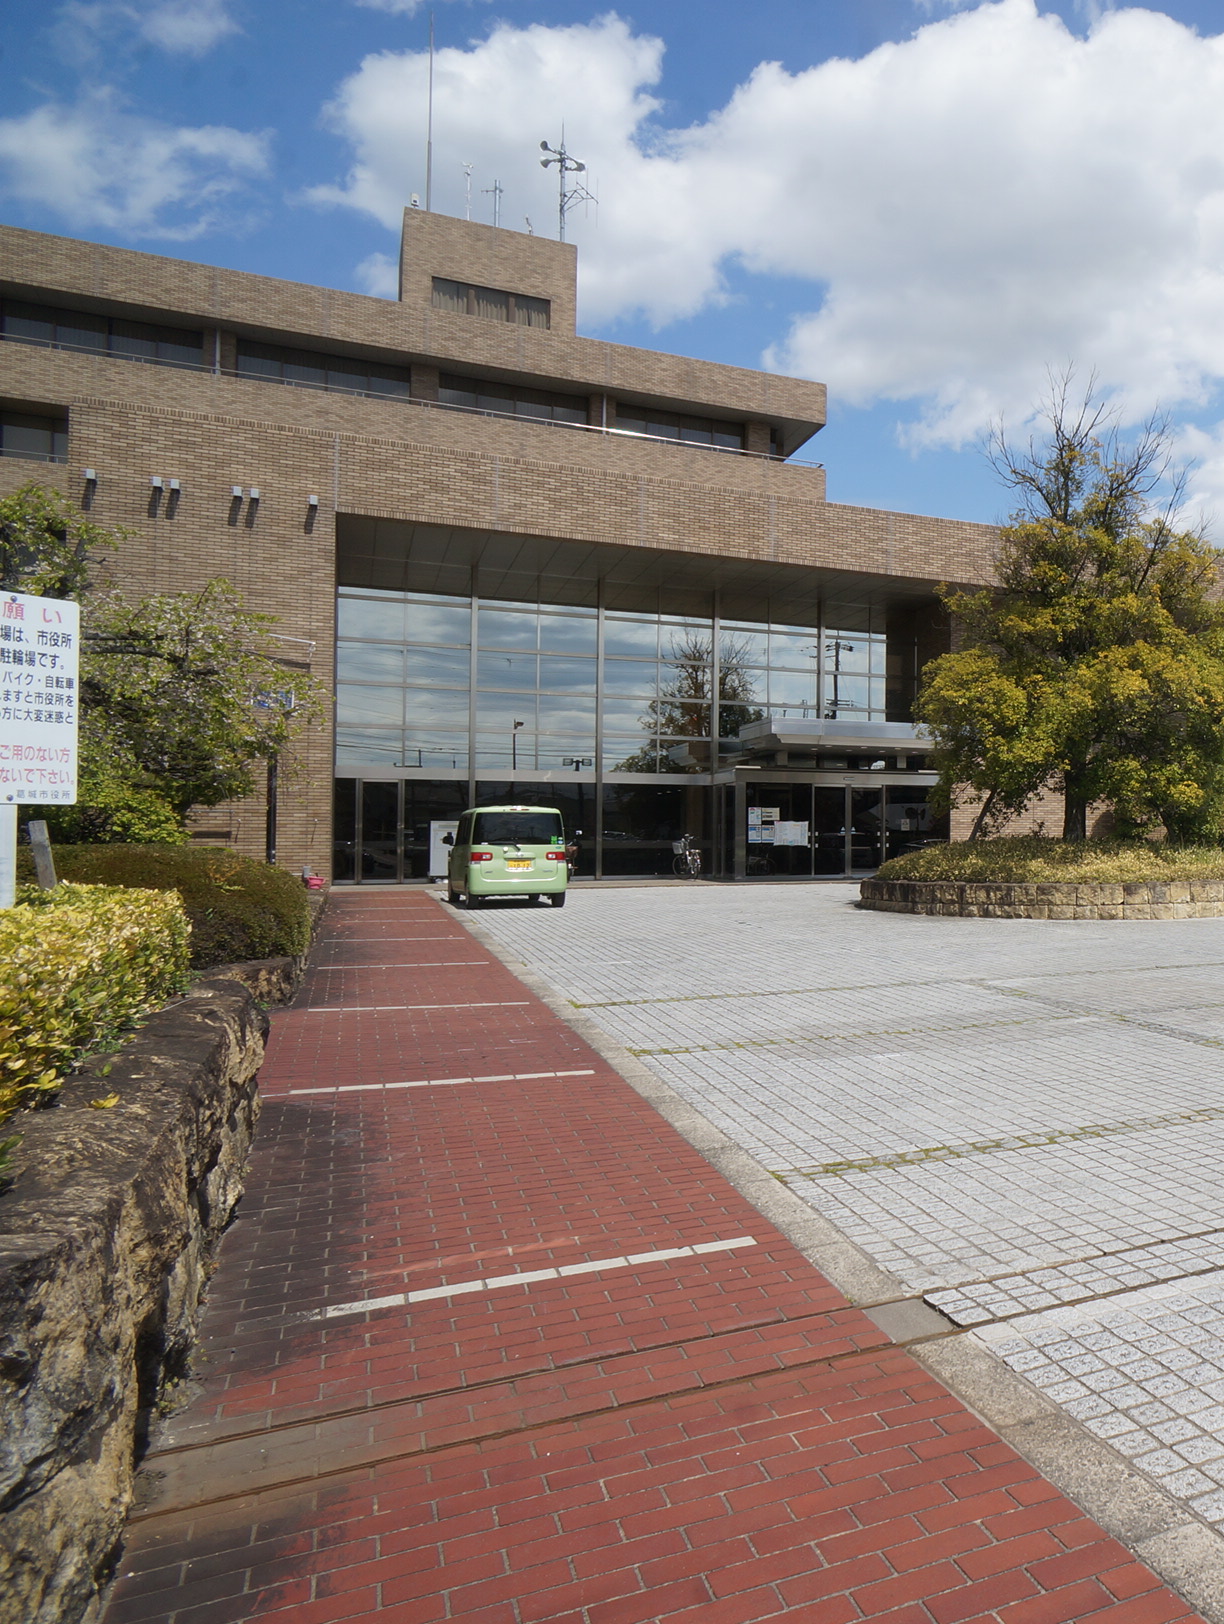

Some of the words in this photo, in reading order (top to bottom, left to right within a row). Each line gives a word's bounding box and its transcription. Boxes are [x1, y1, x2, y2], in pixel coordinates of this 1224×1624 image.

[2, 671, 75, 690] バイク・自転車
[0, 688, 74, 708] ますと市役所を
[0, 707, 74, 725] 方に大変迷惑と
[0, 744, 71, 764] ご用のない方
[16, 789, 71, 800] 葛城市役所
